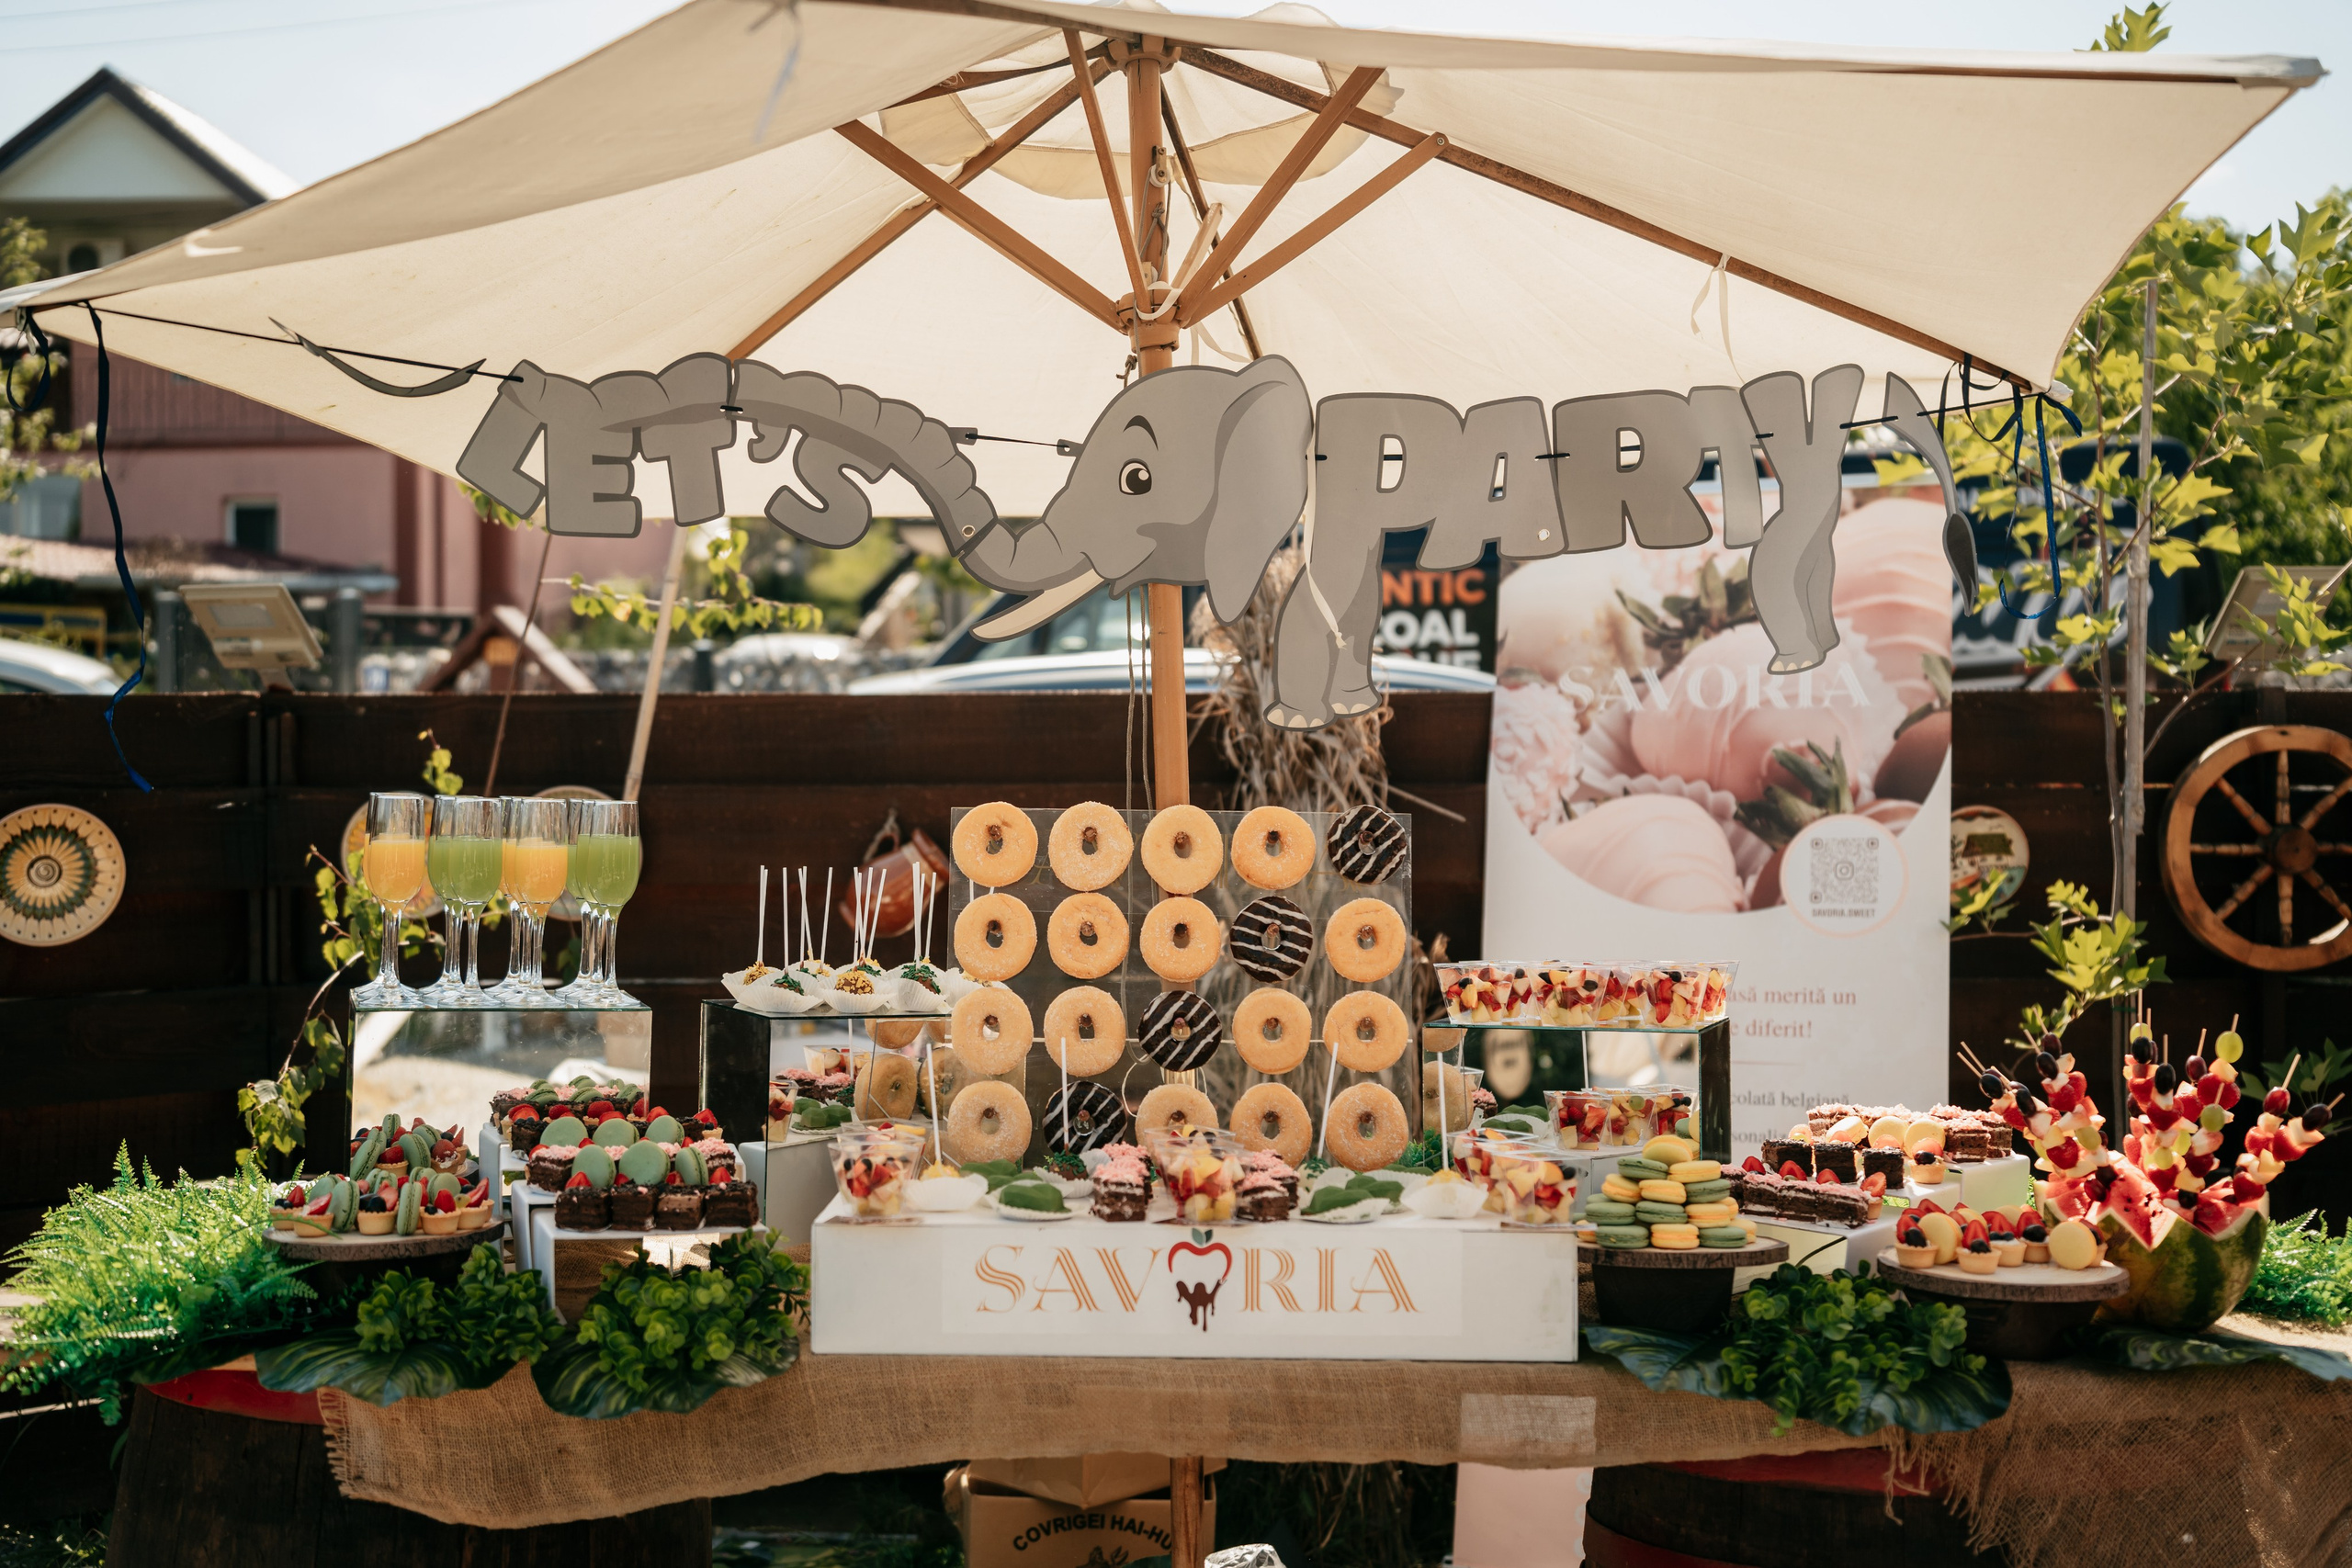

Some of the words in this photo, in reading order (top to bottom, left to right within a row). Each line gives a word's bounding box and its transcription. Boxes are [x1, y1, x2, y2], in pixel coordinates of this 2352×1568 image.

[456, 353, 893, 549] LET'S
[1314, 364, 1865, 675] PARTY
[1382, 569, 1486, 606] NTIC
[1375, 608, 1480, 649] OAL
[1558, 663, 1871, 712] SAVORIA
[1728, 985, 1757, 1003] asă
[1764, 987, 1826, 1004] merită
[1833, 991, 1857, 1005] un
[1746, 1019, 1812, 1038] diferit!
[1732, 1089, 1776, 1107] colată
[1012, 1513, 1106, 1551] COVRIGEI
[1110, 1514, 1172, 1551] HAI-HU
